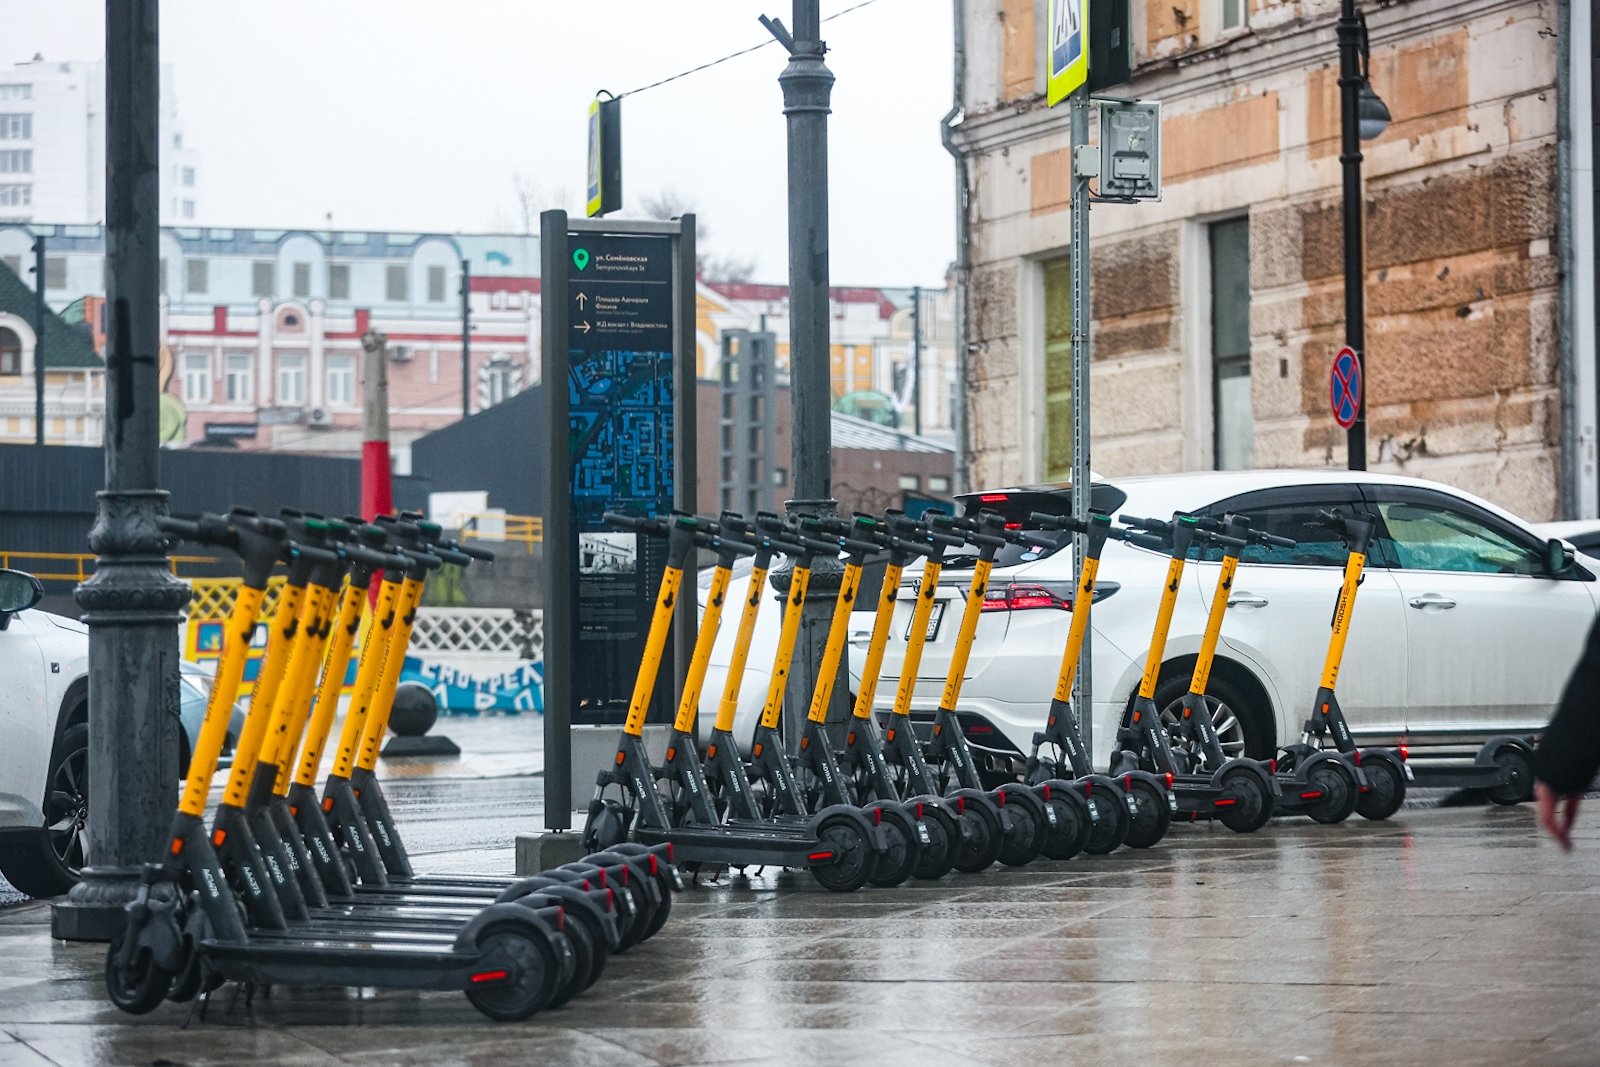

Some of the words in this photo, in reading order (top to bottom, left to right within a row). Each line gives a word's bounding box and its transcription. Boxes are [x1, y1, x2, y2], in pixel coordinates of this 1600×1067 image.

[606, 253, 648, 262] Семёновская
[1333, 596, 1348, 635] WHOOSH
[314, 838, 330, 863] AD3265
